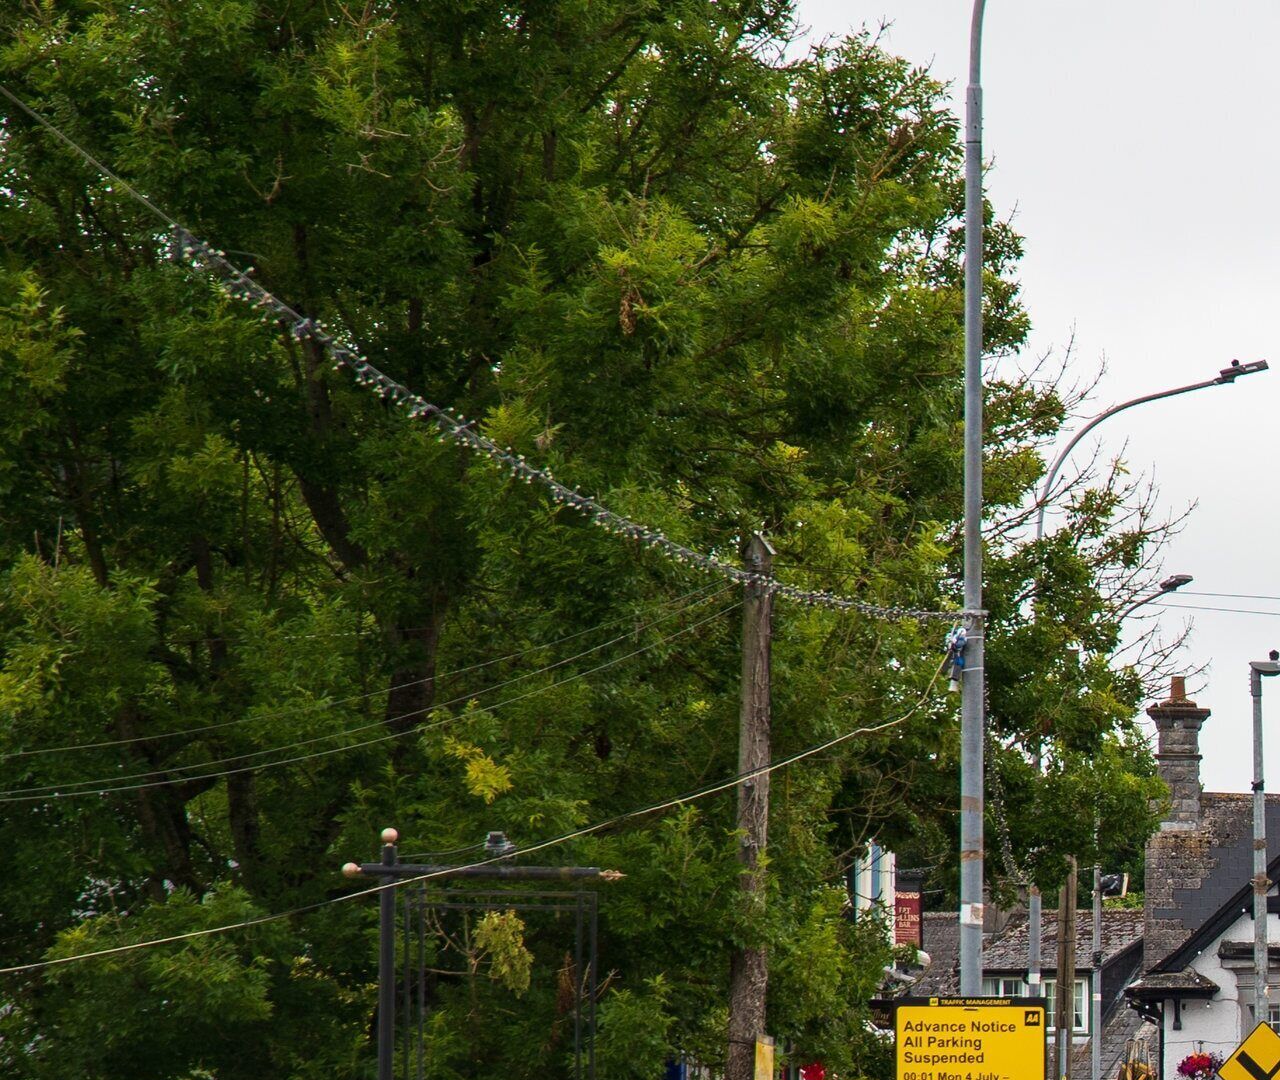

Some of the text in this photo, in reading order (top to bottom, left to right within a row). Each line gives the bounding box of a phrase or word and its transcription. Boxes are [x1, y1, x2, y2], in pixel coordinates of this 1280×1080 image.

[1026, 1013, 1039, 1023] AA
[904, 1021, 966, 1032] Advance
[971, 1021, 1016, 1032] Notice
[904, 1036, 982, 1050] All Parking
[904, 1052, 984, 1066] Suspended
